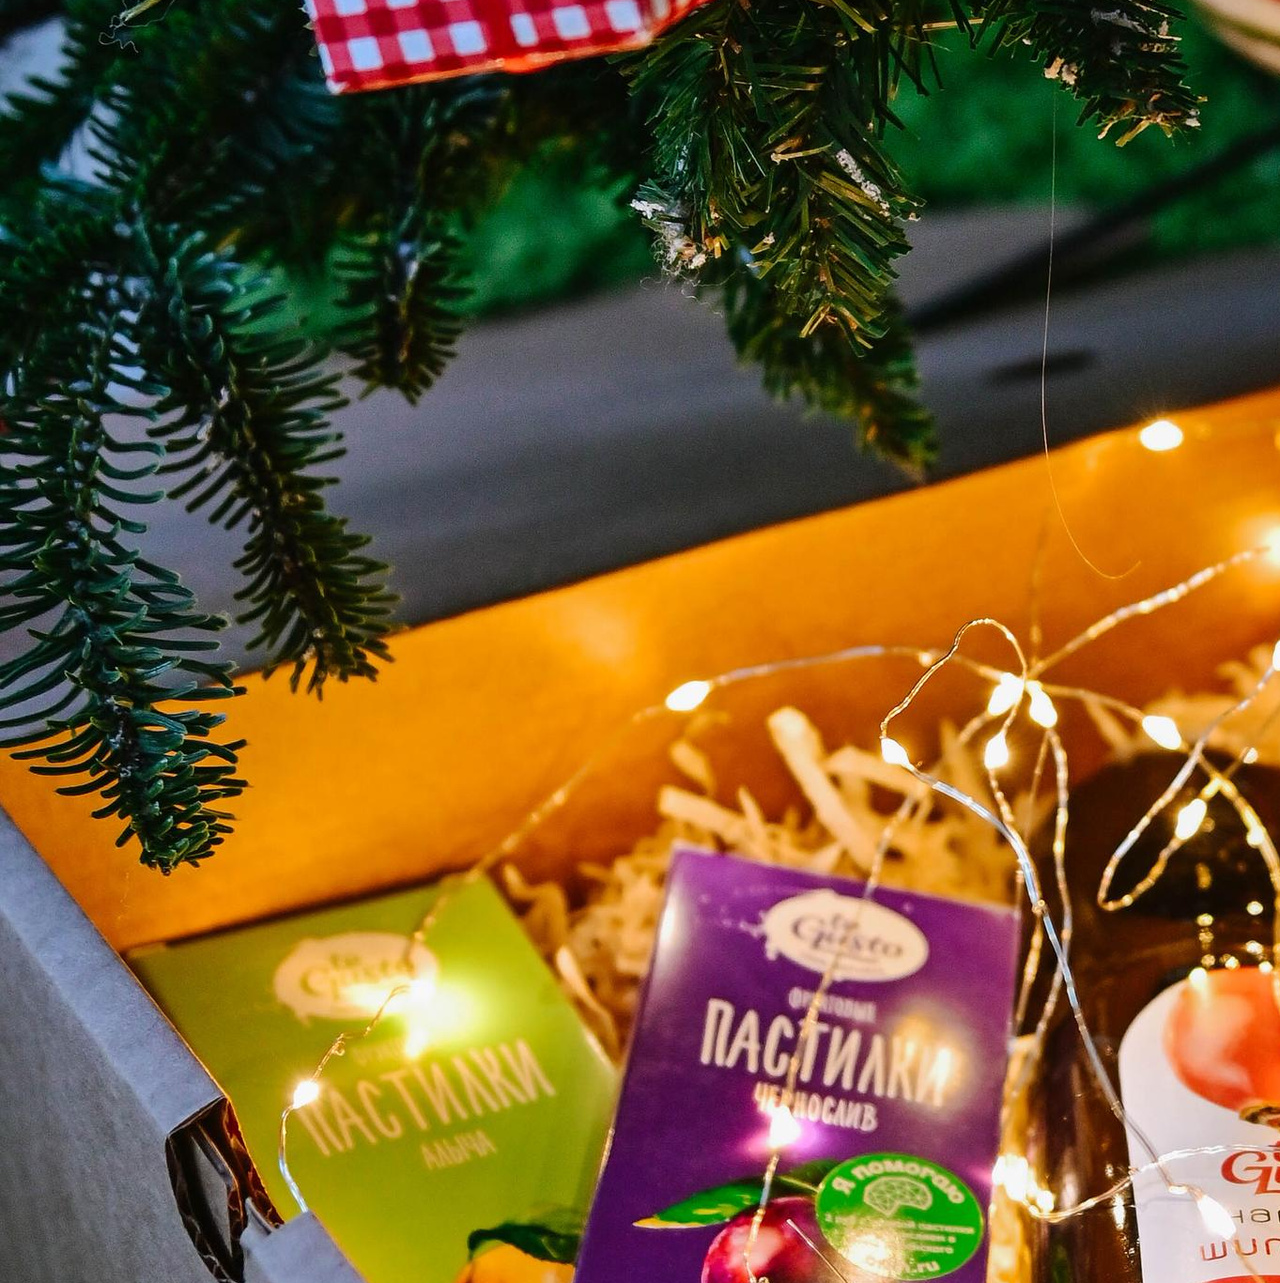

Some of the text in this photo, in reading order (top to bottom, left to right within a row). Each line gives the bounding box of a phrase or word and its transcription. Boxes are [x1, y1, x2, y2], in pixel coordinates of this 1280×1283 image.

[303, 1038, 557, 1157] ПАСТИЛКИ
[701, 998, 945, 1108] ПАСТИЛКИ
[421, 1129, 497, 1171] АЛЫЧА
